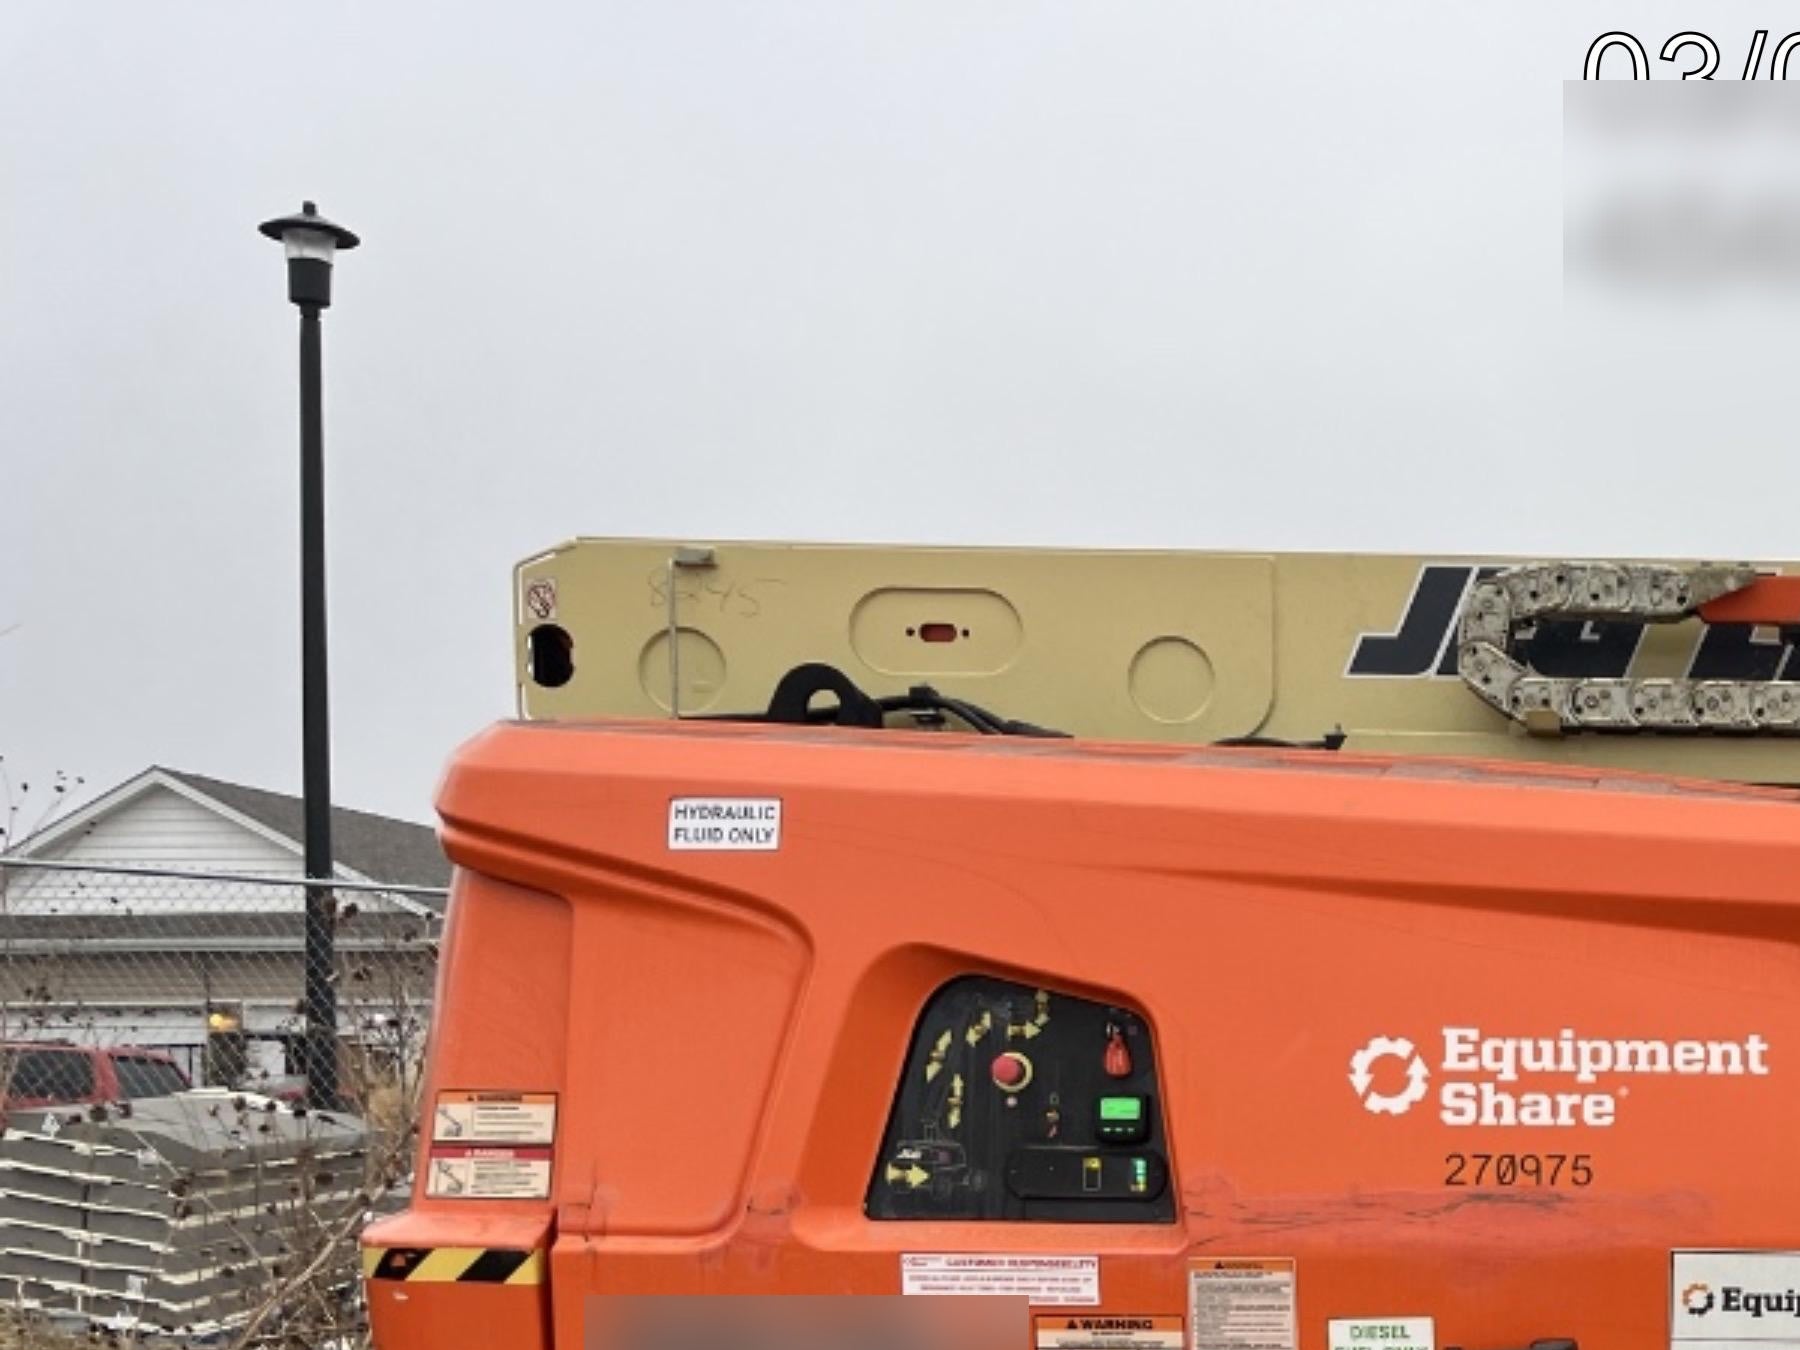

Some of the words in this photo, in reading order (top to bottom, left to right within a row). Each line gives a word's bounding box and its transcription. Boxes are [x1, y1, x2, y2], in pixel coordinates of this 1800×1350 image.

[674, 804, 775, 820] HYDRAULIC
[674, 827, 723, 843] FLUID
[728, 828, 775, 844] ONLY
[1440, 1026, 1769, 1083] Equipment
[1440, 1082, 1616, 1127] Share
[1443, 1152, 1594, 1187] 270975
[1081, 1318, 1154, 1331] WARNING
[1349, 1324, 1411, 1341] DIESEL
